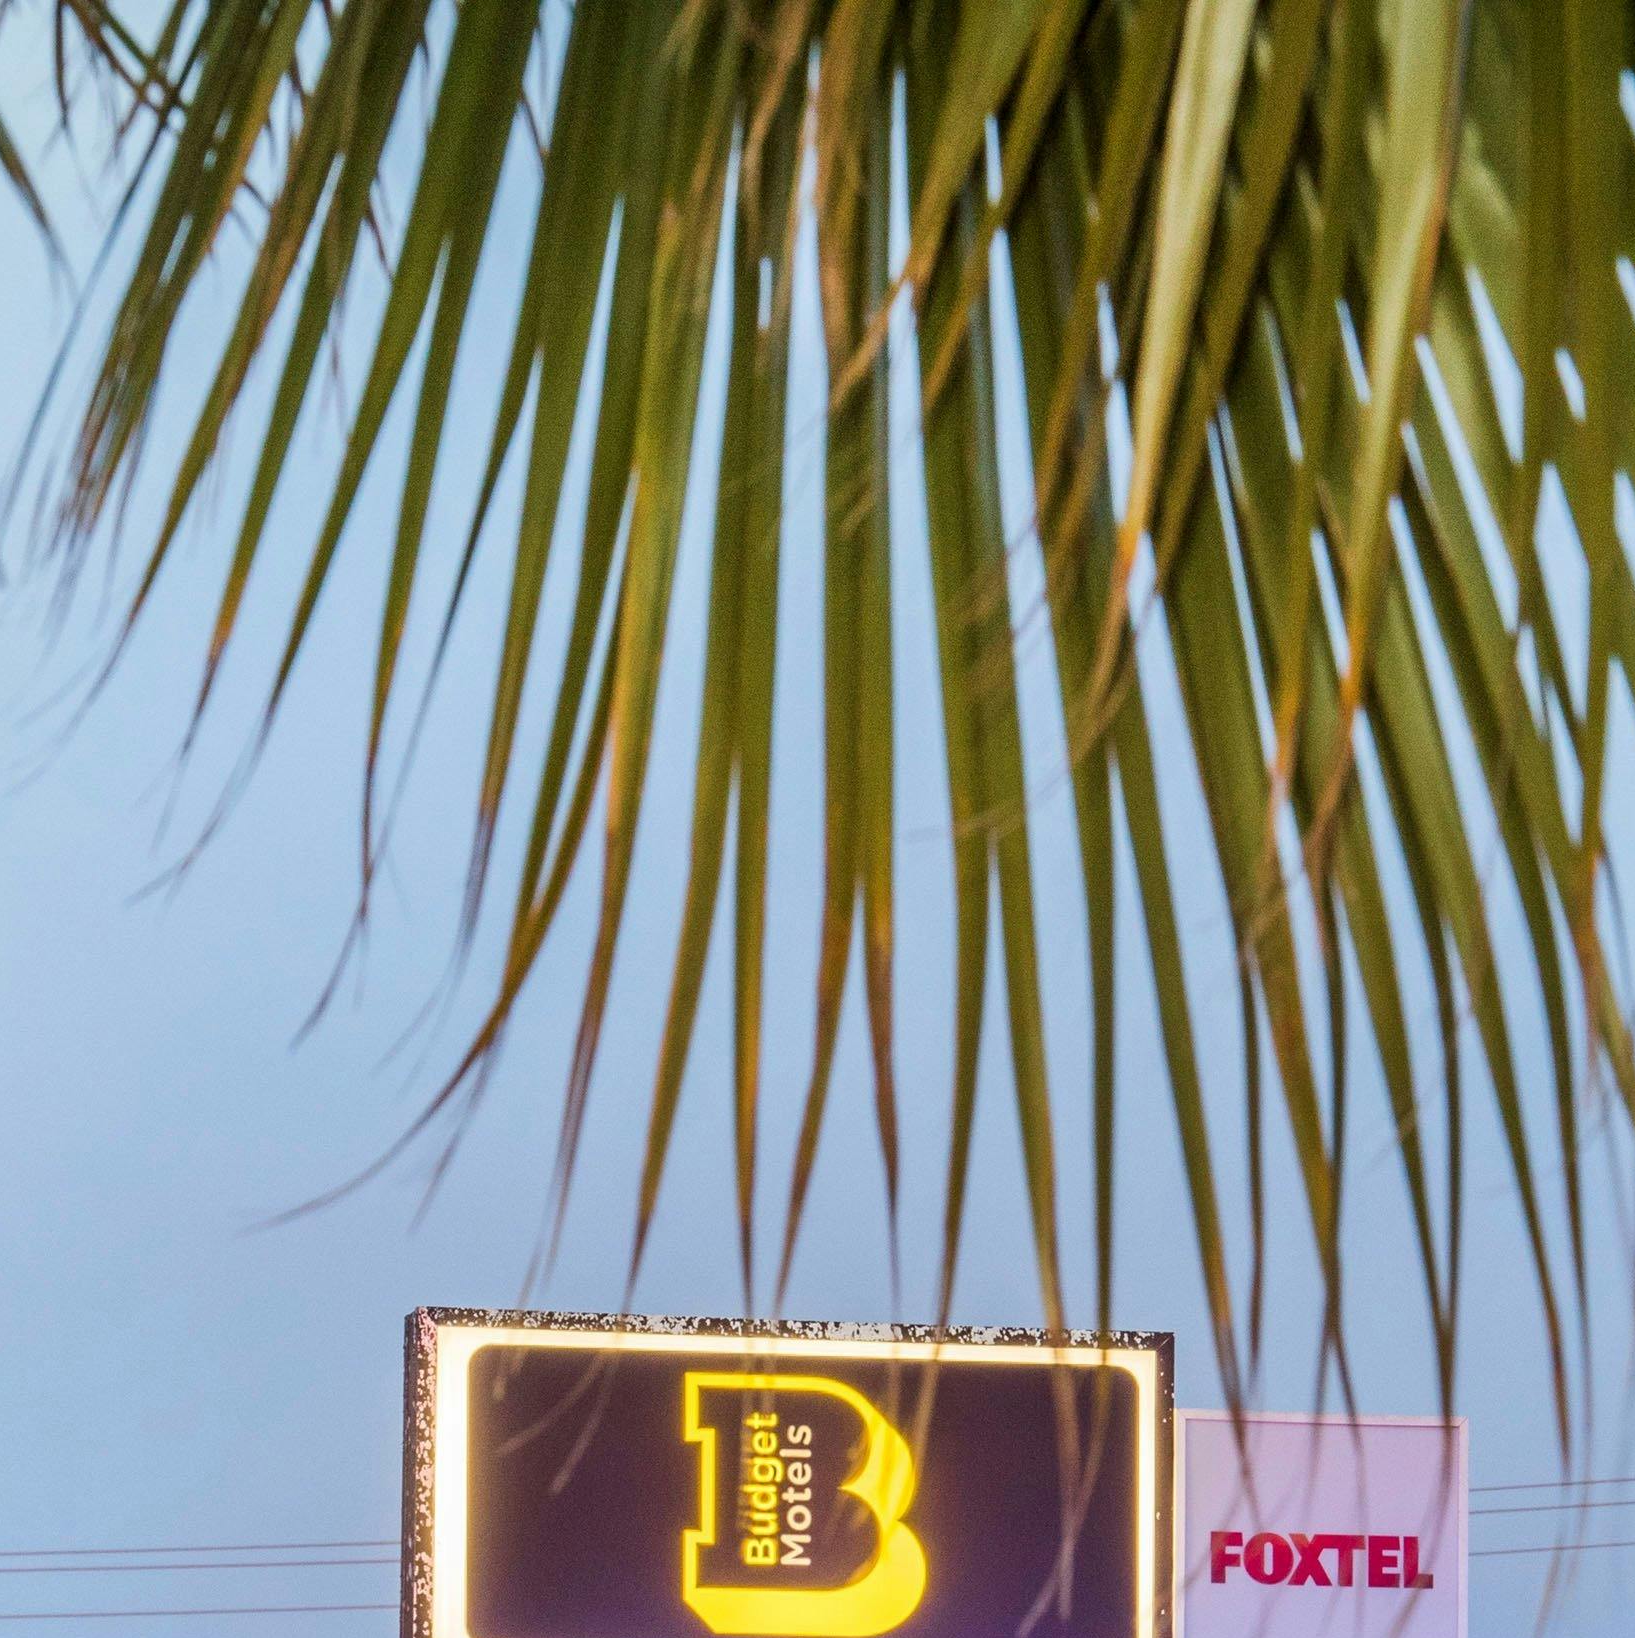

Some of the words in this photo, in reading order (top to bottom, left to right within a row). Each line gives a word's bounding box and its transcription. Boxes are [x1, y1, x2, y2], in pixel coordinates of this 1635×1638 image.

[744, 1412, 783, 1565] Budget
[779, 1424, 812, 1566] Motels
[1210, 1531, 1434, 1589] FOXTEL
